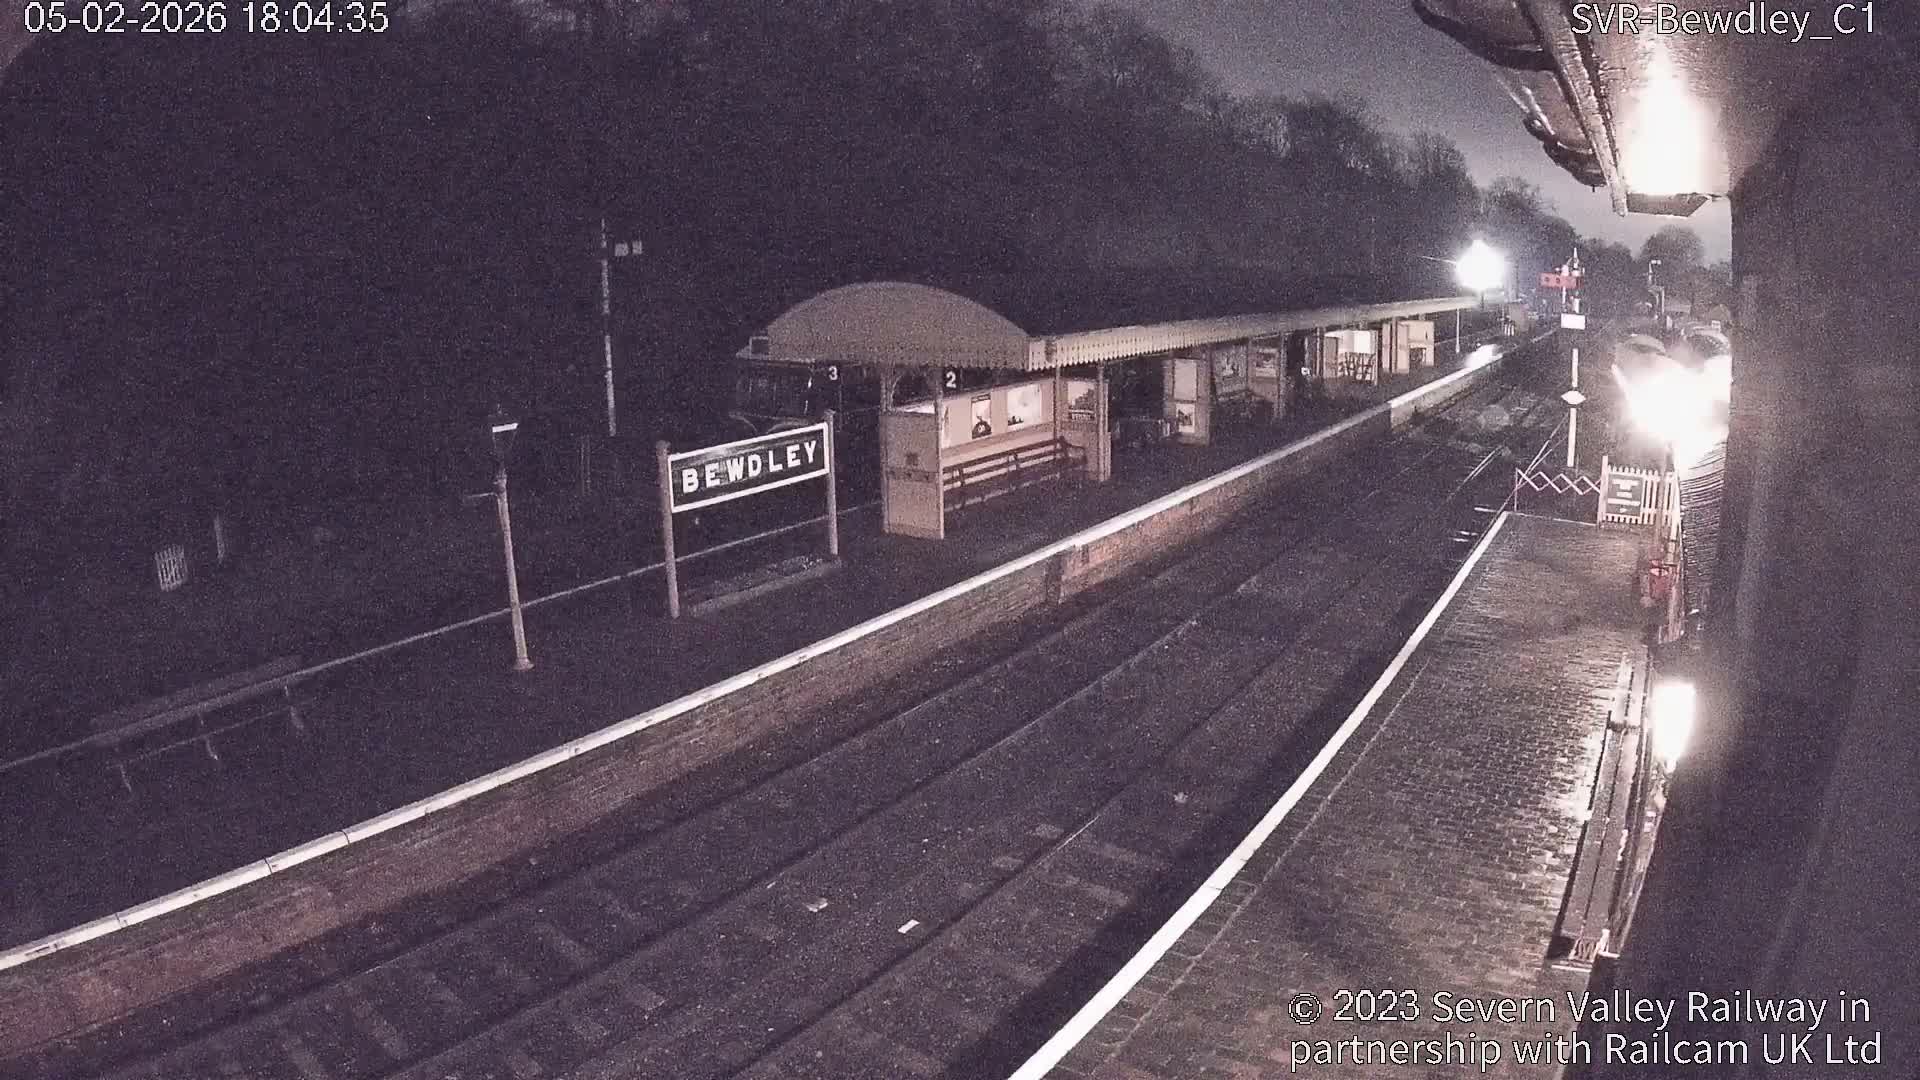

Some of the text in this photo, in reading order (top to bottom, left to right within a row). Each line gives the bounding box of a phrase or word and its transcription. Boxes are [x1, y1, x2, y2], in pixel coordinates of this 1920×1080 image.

[828, 365, 838, 380] 3
[945, 370, 957, 388] 2
[682, 440, 817, 494] BEWDLEY
